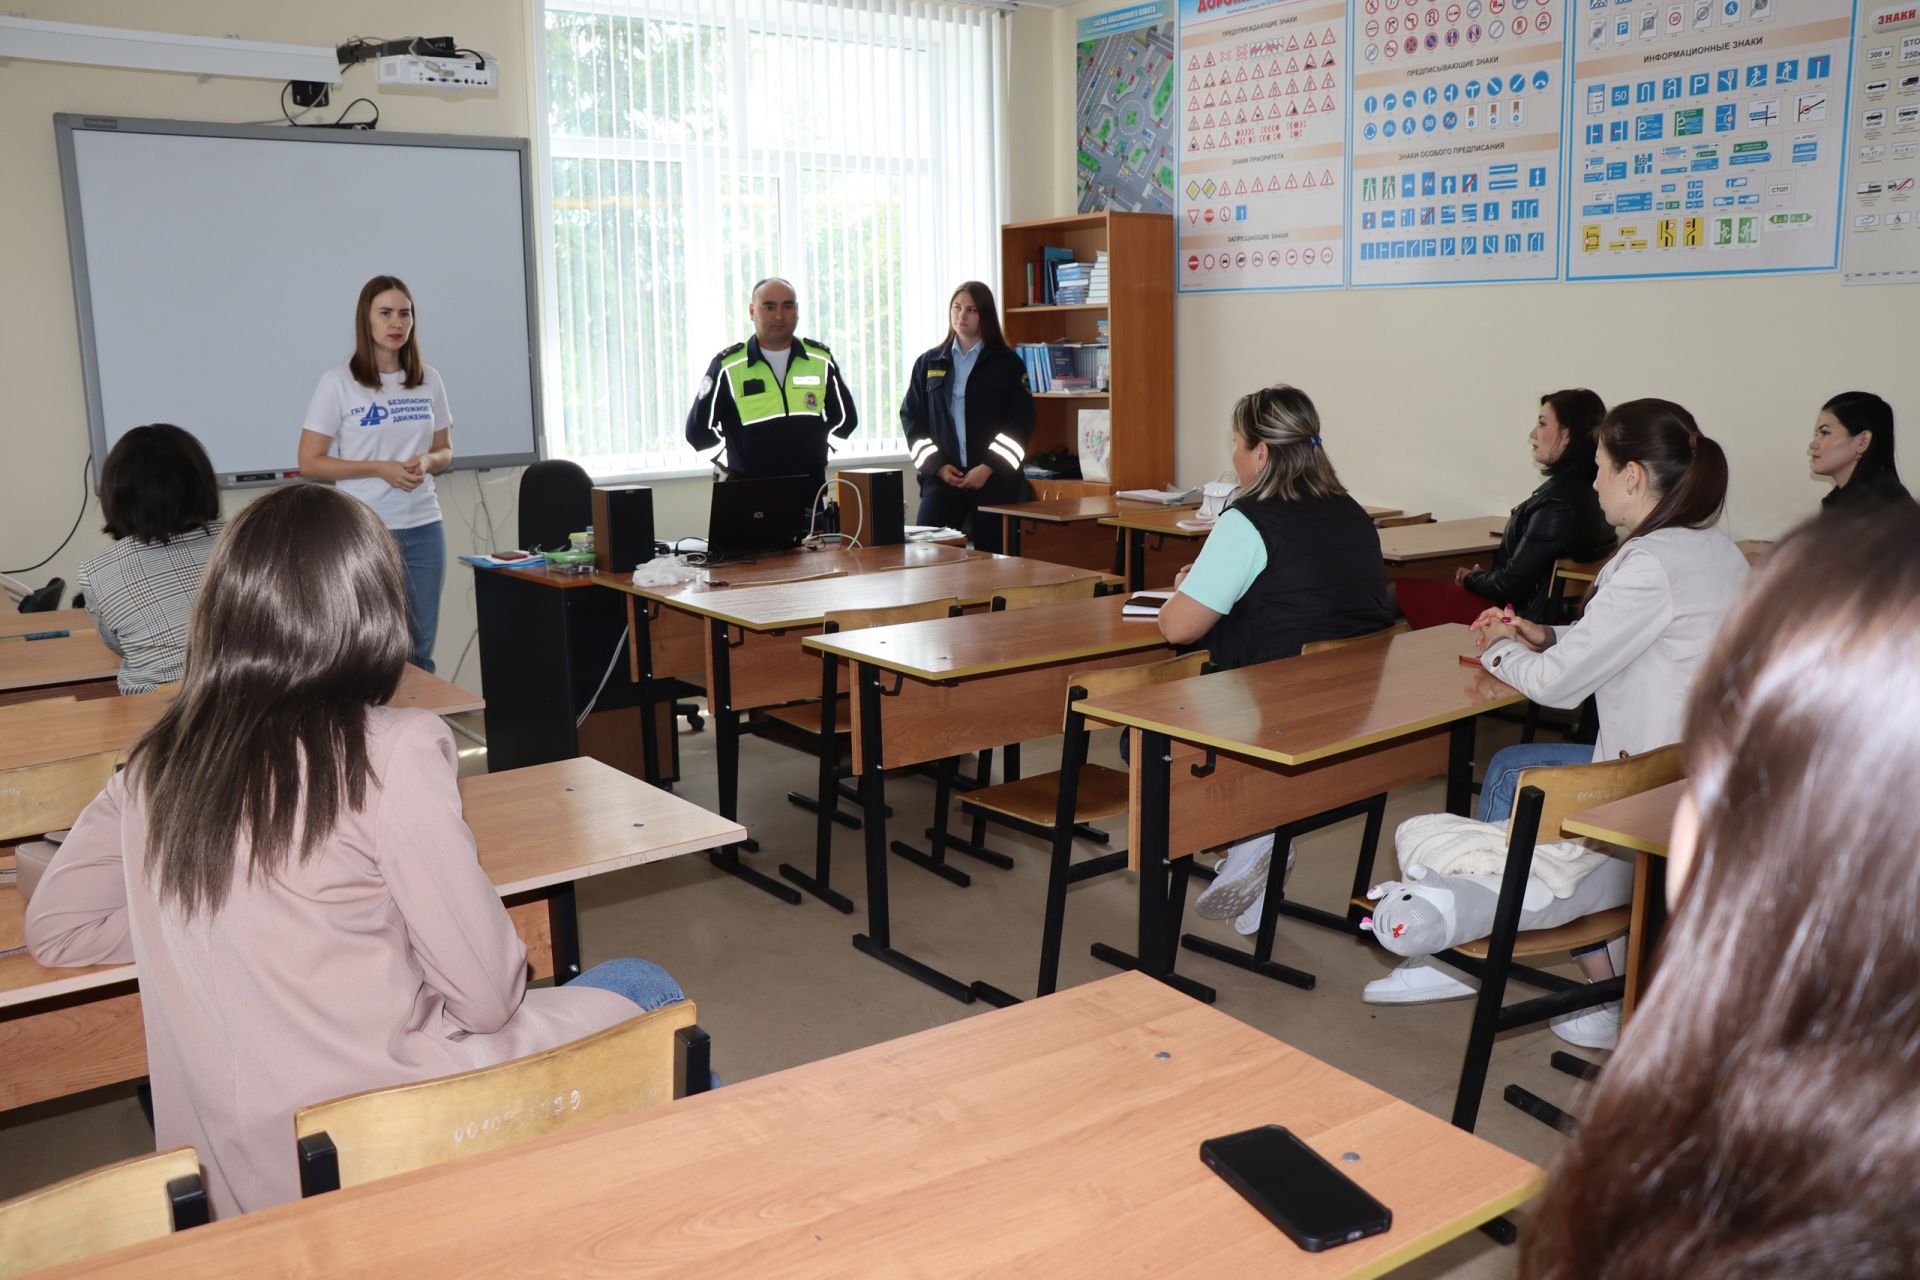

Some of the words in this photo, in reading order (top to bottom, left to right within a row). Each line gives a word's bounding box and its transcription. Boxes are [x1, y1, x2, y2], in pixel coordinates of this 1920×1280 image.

[1878, 9, 1917, 25] ЗНАКИ
[1222, 20, 1278, 38] ПРЕДУПРЕЖДАЮЩИЕ
[1279, 16, 1298, 26] ЗНАКИ
[1903, 37, 1920, 48] STO
[1643, 42, 1730, 63] ИНФОРМАЦИОННЫЕ
[1732, 37, 1764, 49] ЗНАКИ
[1869, 50, 1883, 59] 300
[1406, 60, 1474, 77] ПРЕДПИСЫВАЮЩИЕ
[1475, 56, 1499, 66] ЗНАКИ
[1614, 90, 1627, 101] 50
[1424, 119, 1434, 128] 50
[1398, 150, 1419, 160] ЗНАКИ
[1419, 148, 1452, 158] ОСОБОГО
[1453, 142, 1505, 155] ПРЕДПИСАНИЯ
[1231, 157, 1249, 166] ЗНАКИ
[1249, 153, 1285, 164] ПРИОРИТЕТА
[1227, 234, 1270, 243] ЗАПРЕЩАЮЩИЕ
[1271, 232, 1289, 240] ЗНАКИ
[388, 398, 433, 406] БЕЗОПАСНОС
[351, 406, 366, 415] ГБУ
